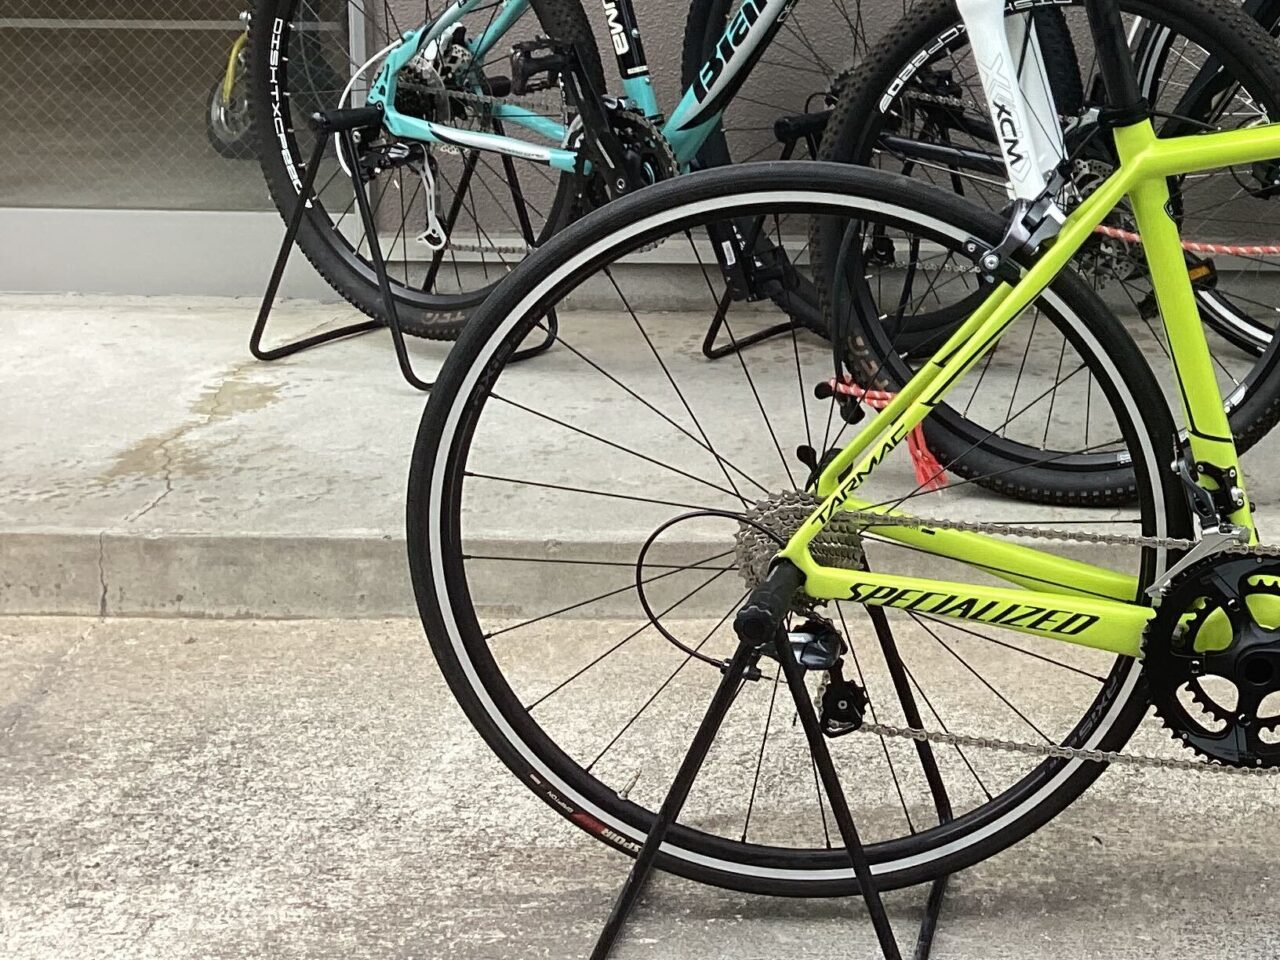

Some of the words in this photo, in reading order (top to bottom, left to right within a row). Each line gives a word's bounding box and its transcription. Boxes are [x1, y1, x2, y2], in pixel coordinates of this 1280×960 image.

[992, 101, 1025, 167] XCM
[812, 422, 910, 526] TARMAC
[849, 582, 1100, 636] SPECIALIZED
[600, 827, 643, 853] SPOIR
